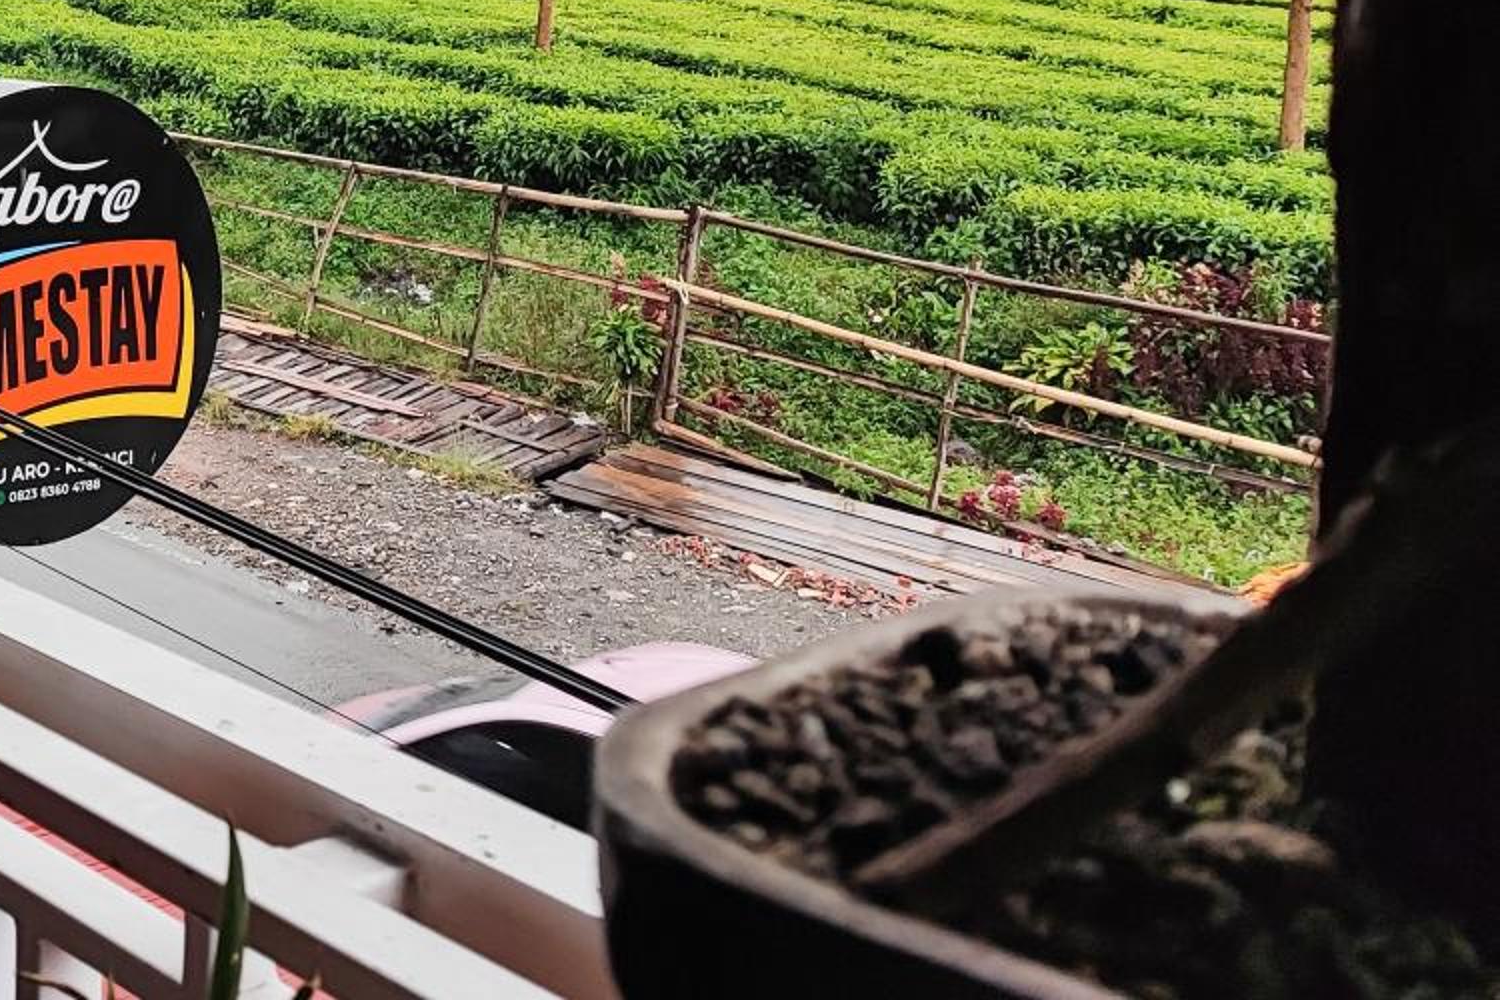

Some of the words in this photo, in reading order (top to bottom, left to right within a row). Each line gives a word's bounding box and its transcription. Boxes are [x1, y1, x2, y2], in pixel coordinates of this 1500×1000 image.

[11, 461, 50, 483] ARO
[8, 486, 38, 503] 0823
[40, 482, 69, 498] 8360
[71, 478, 101, 493] 4788
